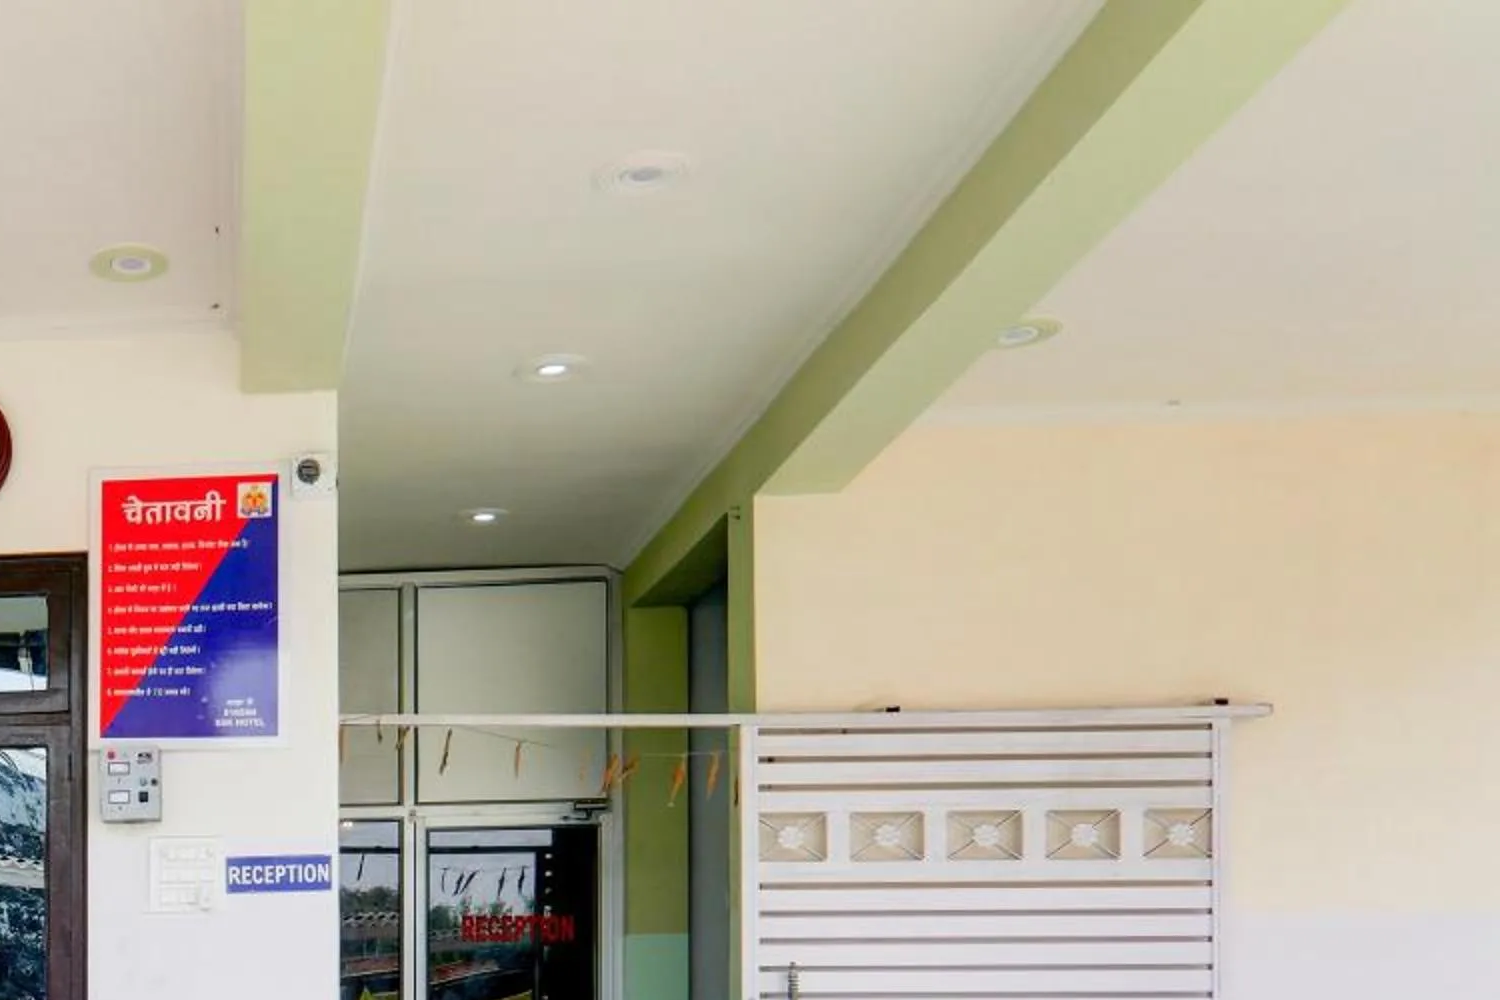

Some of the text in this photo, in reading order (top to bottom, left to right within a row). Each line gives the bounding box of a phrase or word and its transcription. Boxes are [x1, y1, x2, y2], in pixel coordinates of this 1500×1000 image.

[121, 490, 227, 525] चेतावनी
[228, 863, 330, 885] RECEPTION
[461, 915, 575, 942] RECEPTION
